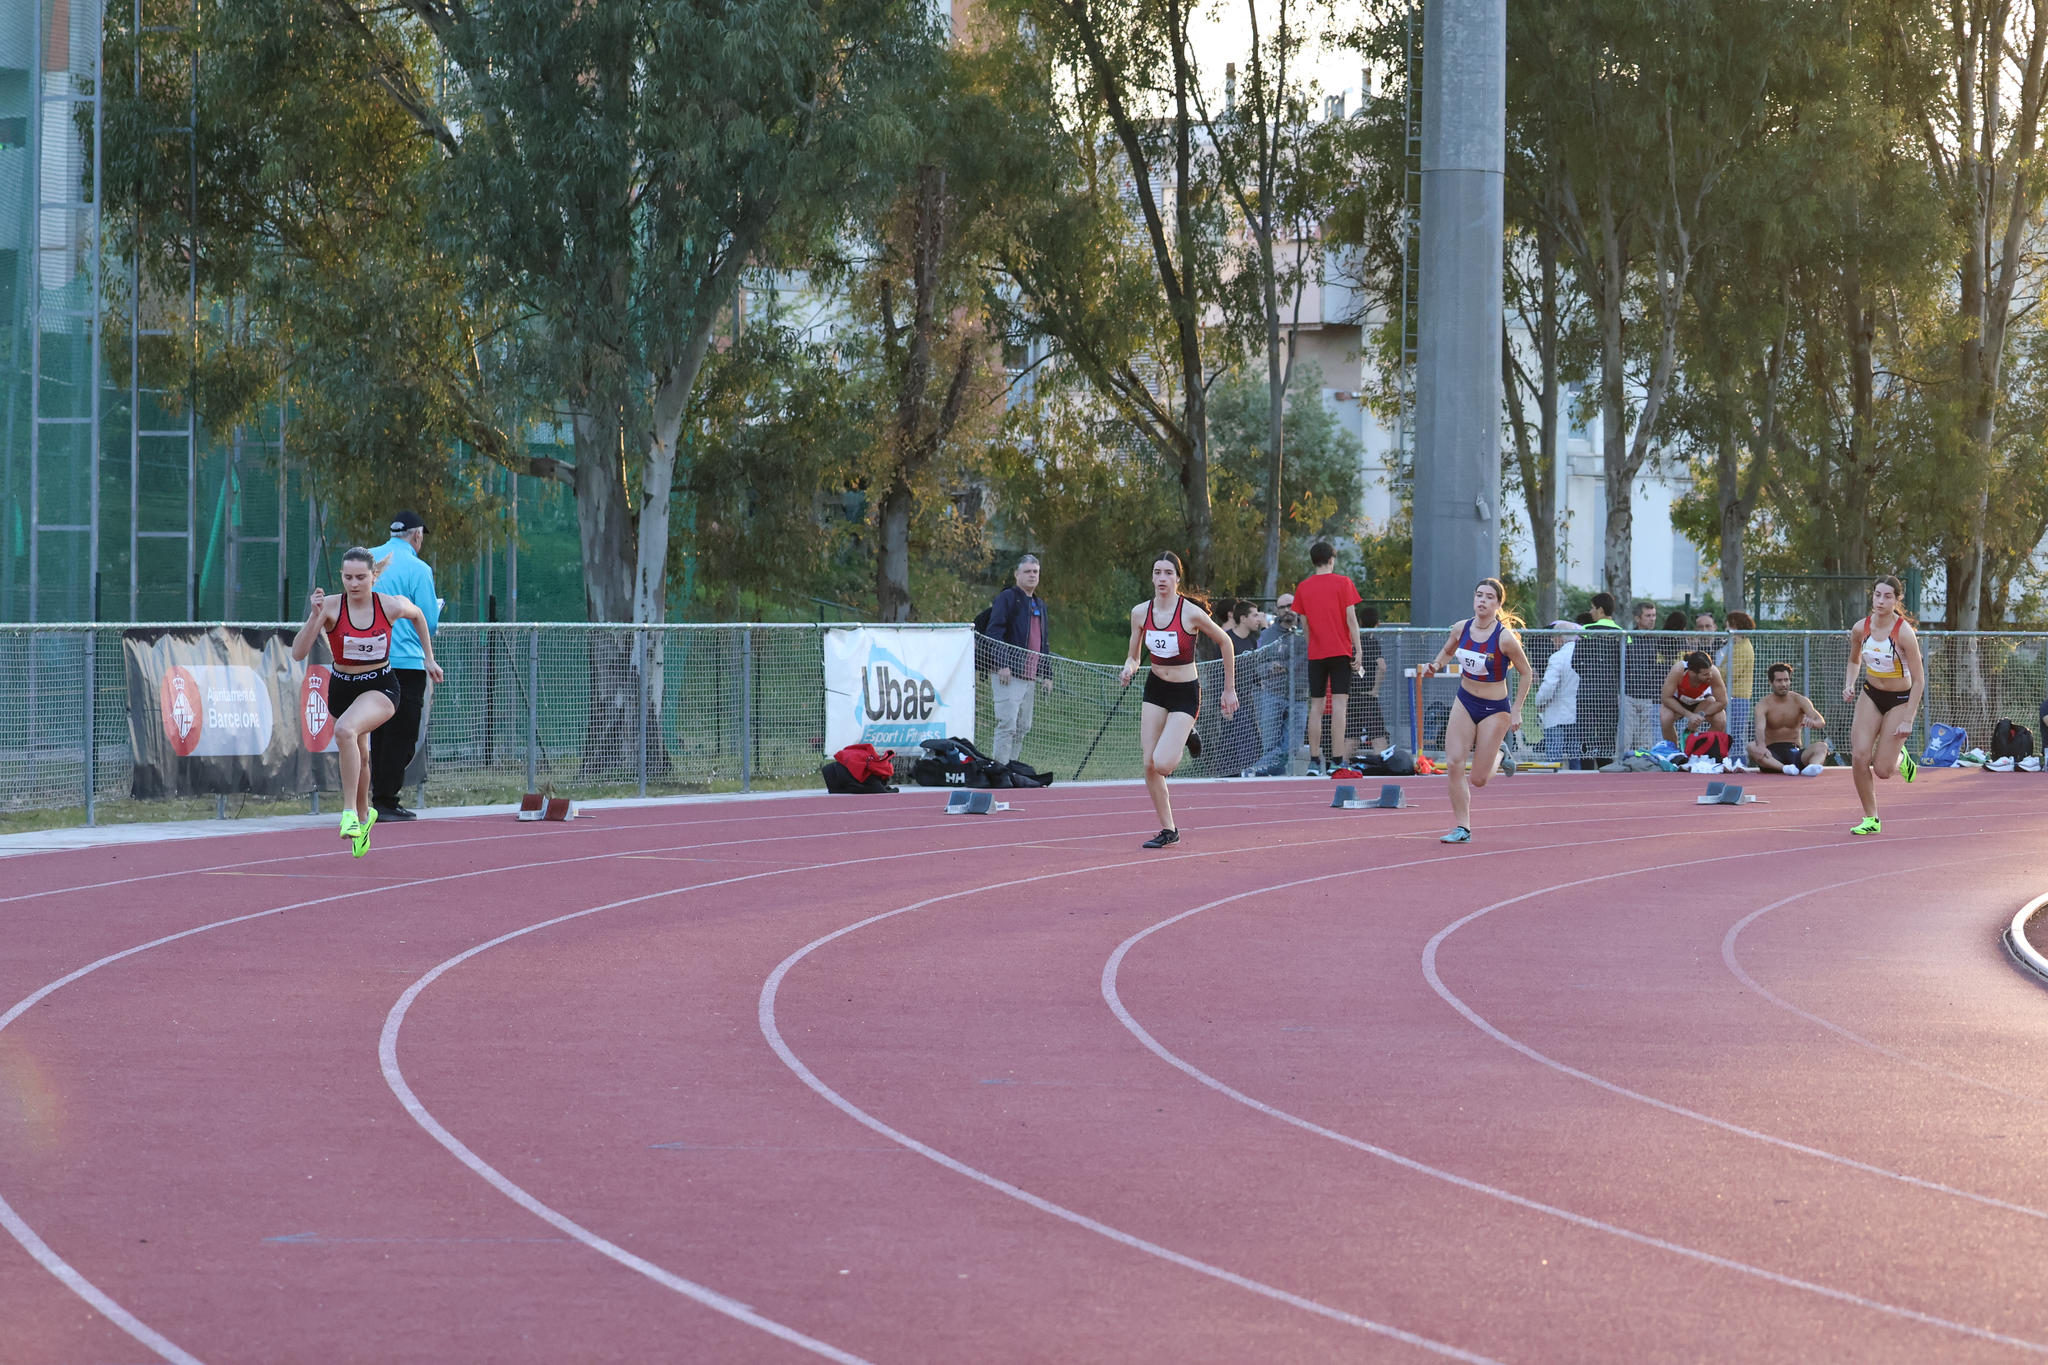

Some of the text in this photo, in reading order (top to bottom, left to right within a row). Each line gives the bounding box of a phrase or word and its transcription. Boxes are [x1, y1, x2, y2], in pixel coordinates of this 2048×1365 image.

[358, 644, 373, 653] 33
[1155, 639, 1166, 649] 32
[332, 668, 351, 681] NIKE
[353, 671, 378, 681] PRO
[861, 666, 936, 721] Ubae
[864, 728, 898, 746] Esport
